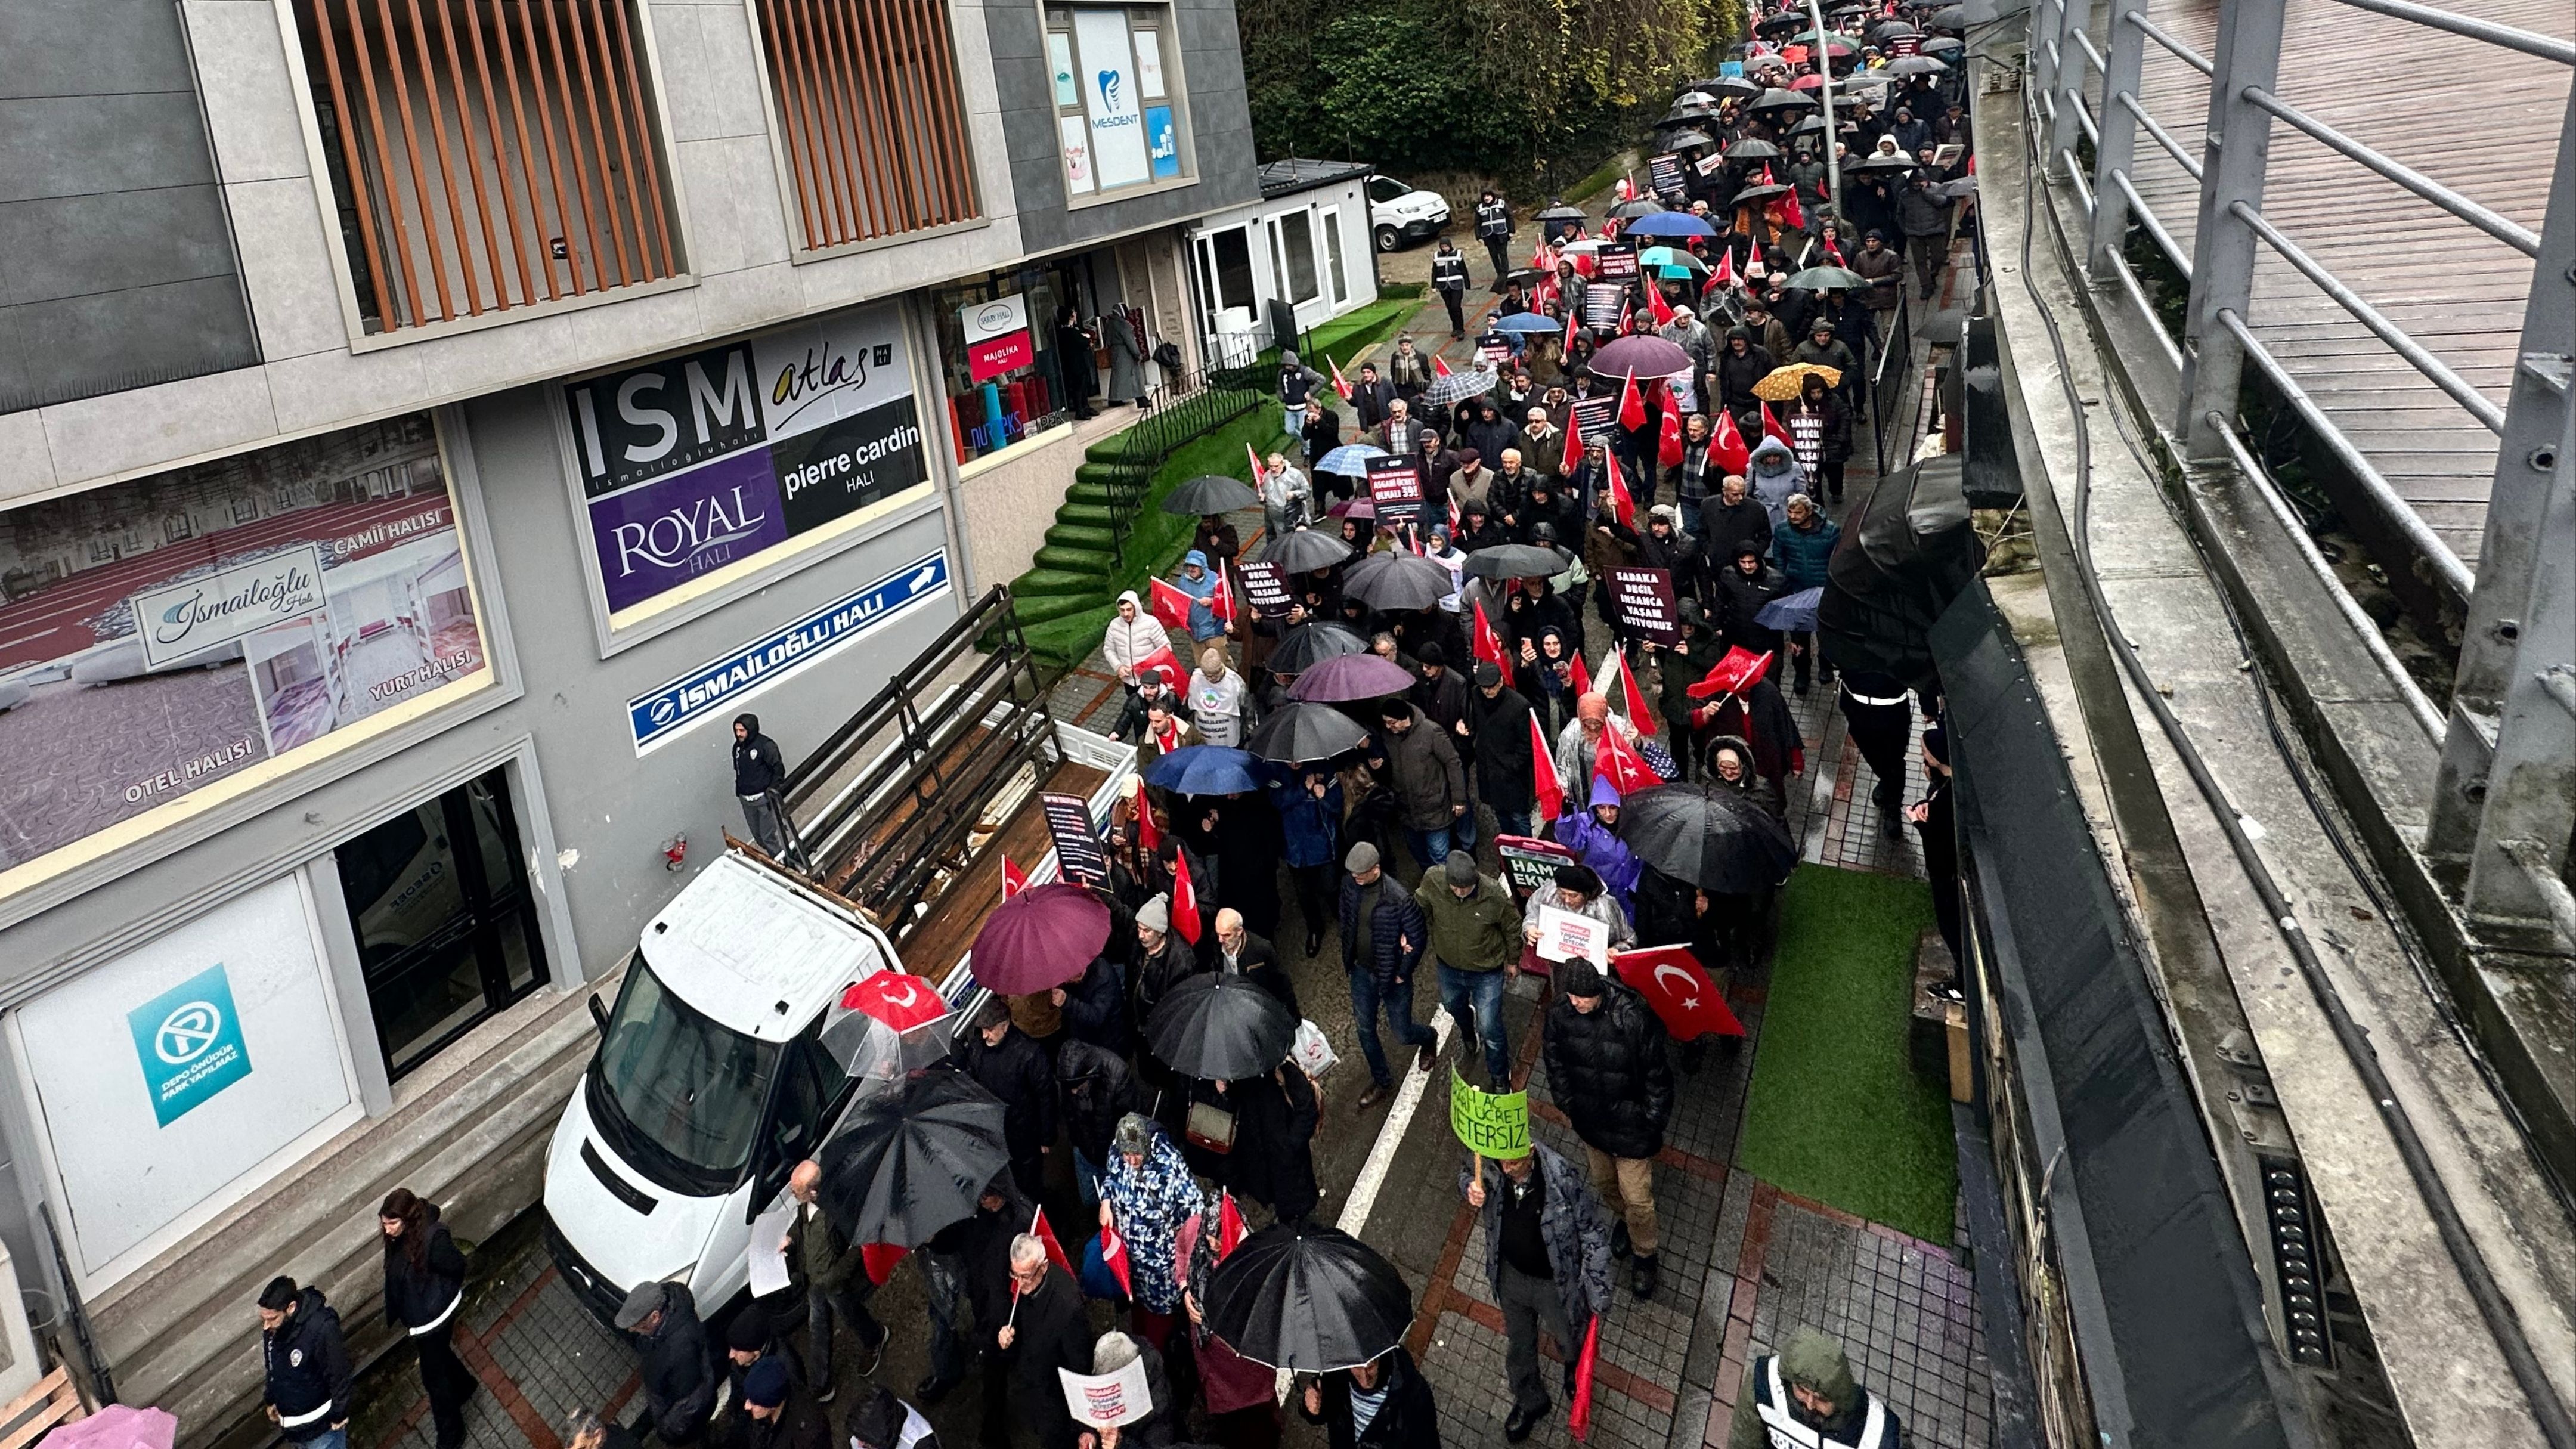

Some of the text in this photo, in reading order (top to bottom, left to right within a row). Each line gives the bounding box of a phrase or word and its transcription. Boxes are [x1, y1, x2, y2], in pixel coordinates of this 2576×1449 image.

[1092, 114, 1138, 129] MESDENT
[772, 341, 868, 406] atlas
[575, 349, 756, 478] ISM
[785, 425, 919, 500] pierre cardin
[846, 470, 875, 493] HALI
[1401, 485, 1419, 498] 39!
[333, 509, 442, 556] CAMİİ HALISI
[611, 485, 766, 578] ROYAL
[689, 544, 731, 574] HALI
[1616, 572, 1659, 583] SADAKA
[156, 566, 311, 644] İsmailoğlu
[1622, 614, 1673, 631] İSTİYORUZ
[369, 649, 472, 701] YURT HALISI
[679, 593, 883, 713] İSMAİLOĞLU HALI
[124, 739, 255, 804] OTEL HALISI
[1511, 859, 1558, 877] HAM
[162, 1044, 234, 1091] DEPO ÖNÜDÜR
[162, 1050, 239, 1101] PARK YAPILMAZ
